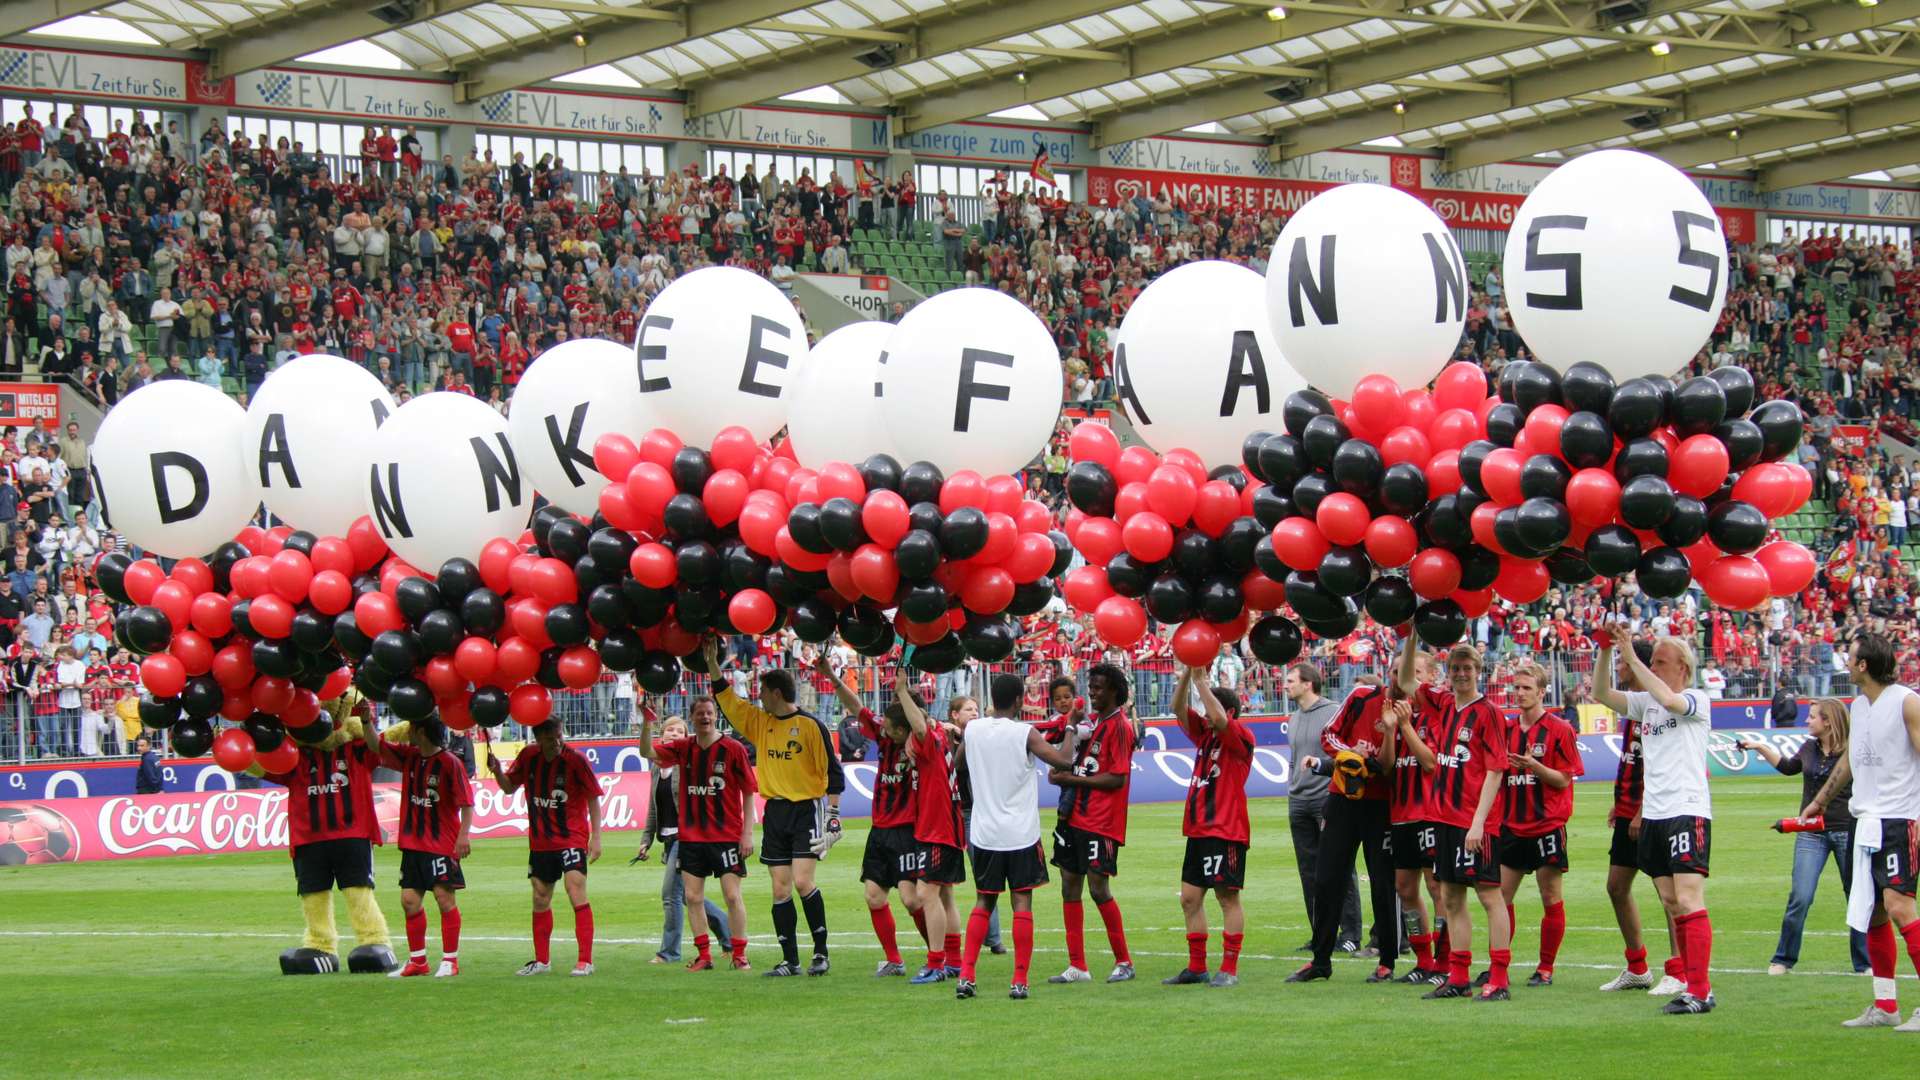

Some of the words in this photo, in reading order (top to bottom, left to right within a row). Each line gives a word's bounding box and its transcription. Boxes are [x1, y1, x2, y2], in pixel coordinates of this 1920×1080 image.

[31, 52, 88, 90] EVL
[91, 73, 123, 93] Zeit
[126, 76, 149, 96] für
[152, 79, 181, 98] Sie.
[298, 75, 356, 112] EVL
[364, 95, 393, 114] Zeit
[398, 98, 419, 117] für
[423, 100, 450, 119] Sie.
[516, 92, 566, 128] EVL
[571, 111, 597, 130] Zeit
[601, 113, 620, 132] für
[624, 116, 650, 134] Sie.
[703, 110, 750, 141] EVL
[755, 125, 781, 144] Zeit
[784, 128, 802, 146] für
[806, 131, 830, 148] Sie.
[990, 136, 1025, 155] zum
[1135, 140, 1176, 171] EVL
[1180, 155, 1201, 172] Zeit
[1204, 157, 1220, 173] für
[1224, 160, 1242, 175] Sie.
[1321, 165, 1340, 181] Zeit
[1345, 167, 1359, 182] für
[1495, 177, 1514, 193] Zeit
[1786, 192, 1814, 206] zum
[1524, 214, 1588, 311] S
[1669, 210, 1720, 312] S
[1287, 234, 1339, 328] N
[1422, 232, 1464, 324] N
[636, 314, 674, 393] E
[738, 314, 791, 398] E
[1218, 330, 1271, 418] A
[18, 393, 57, 406] MITGLIED
[953, 347, 1015, 433] F
[259, 413, 303, 489] A
[544, 401, 600, 488] K
[470, 432, 522, 513] N
[150, 451, 211, 525] D
[370, 462, 414, 539] N
[768, 749, 793, 760] RWE
[1395, 756, 1418, 769] RWE
[307, 783, 340, 796] RWE
[688, 786, 717, 796] RWE
[1508, 774, 1537, 786] RWE
[98, 790, 290, 854] Coca-Cola
[1088, 840, 1099, 860] 3
[1418, 828, 1435, 850] 26
[1537, 834, 1556, 858] 13
[1669, 831, 1690, 857] 28
[432, 857, 447, 877] 15
[563, 848, 581, 866] 25
[721, 848, 739, 868] 16
[1203, 855, 1222, 876] 27
[1886, 853, 1899, 877] 9
